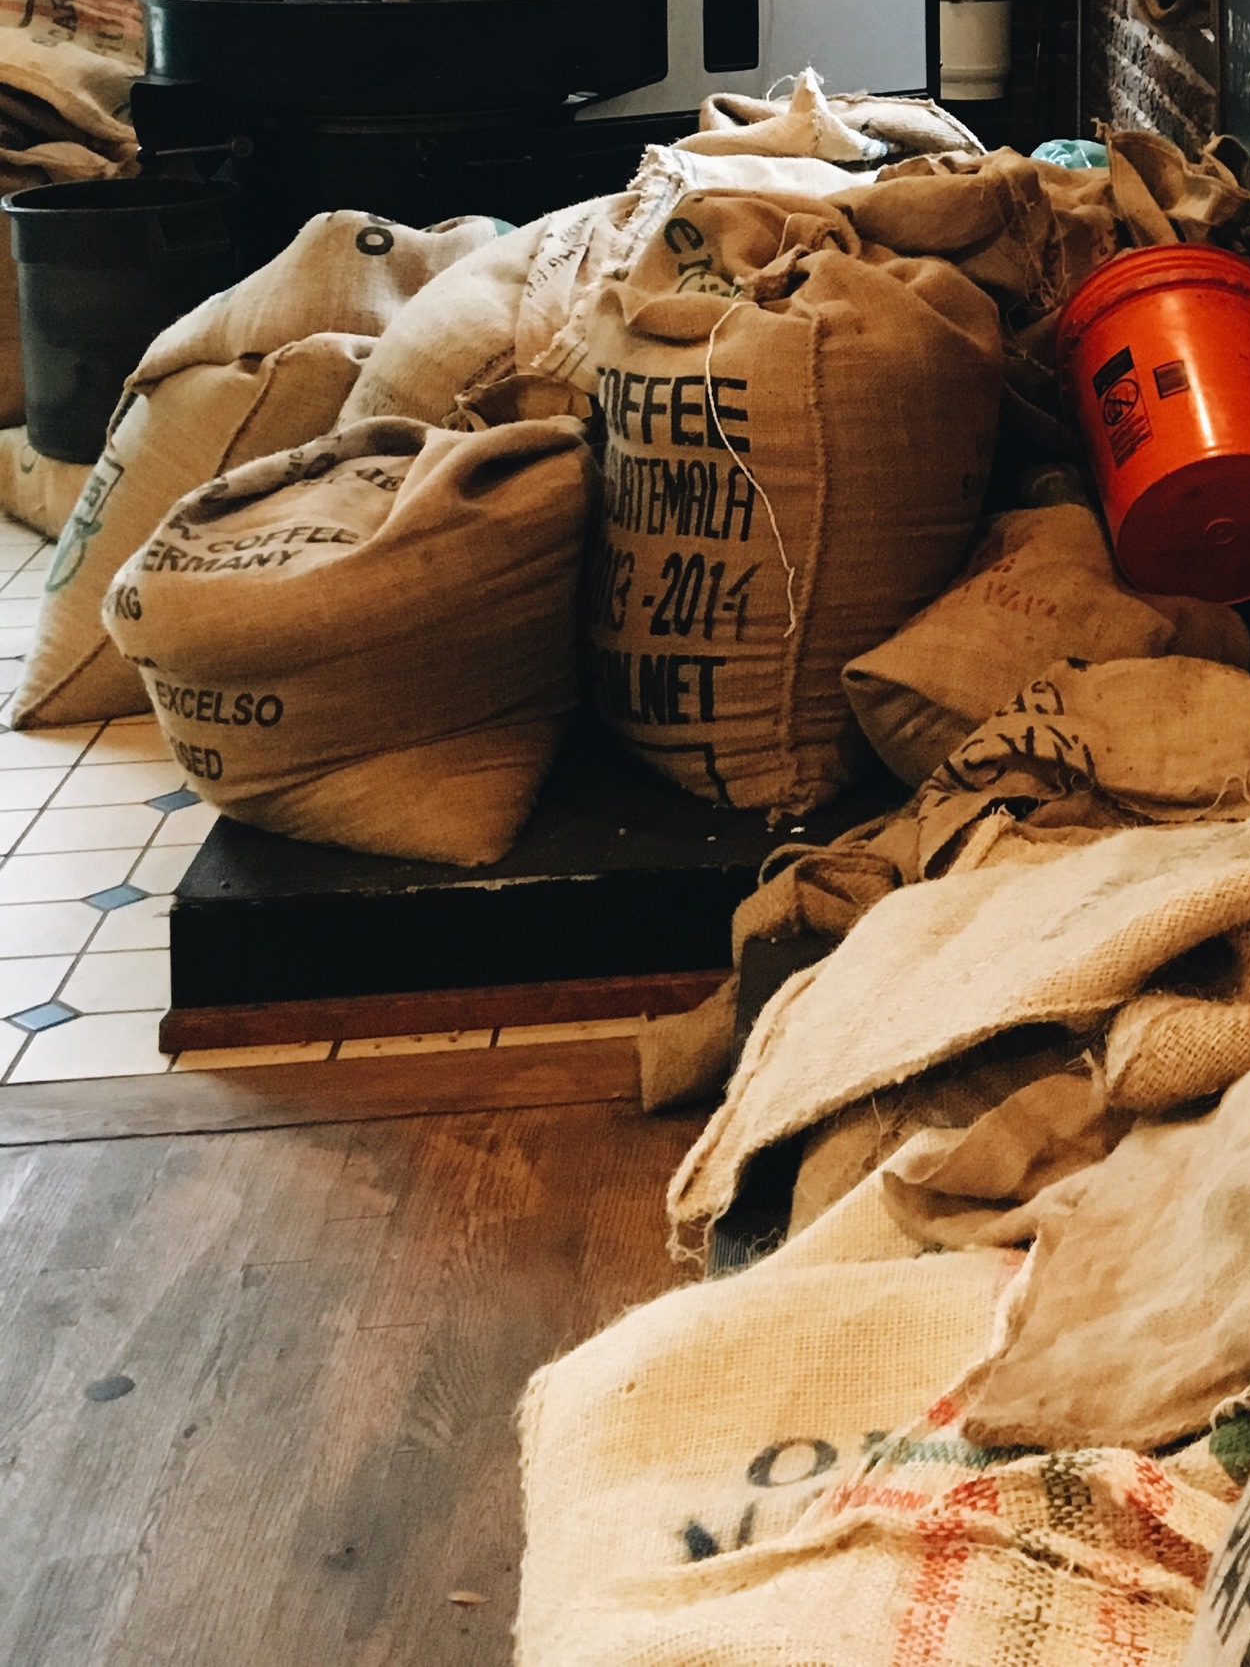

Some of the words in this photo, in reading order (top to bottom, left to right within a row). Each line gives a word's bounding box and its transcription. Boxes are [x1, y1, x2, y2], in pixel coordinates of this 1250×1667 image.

[604, 449, 756, 542] UATEMALA
[139, 540, 302, 572] ERMANY
[207, 525, 359, 554] COFFEE
[155, 680, 284, 727] EXCELSO
